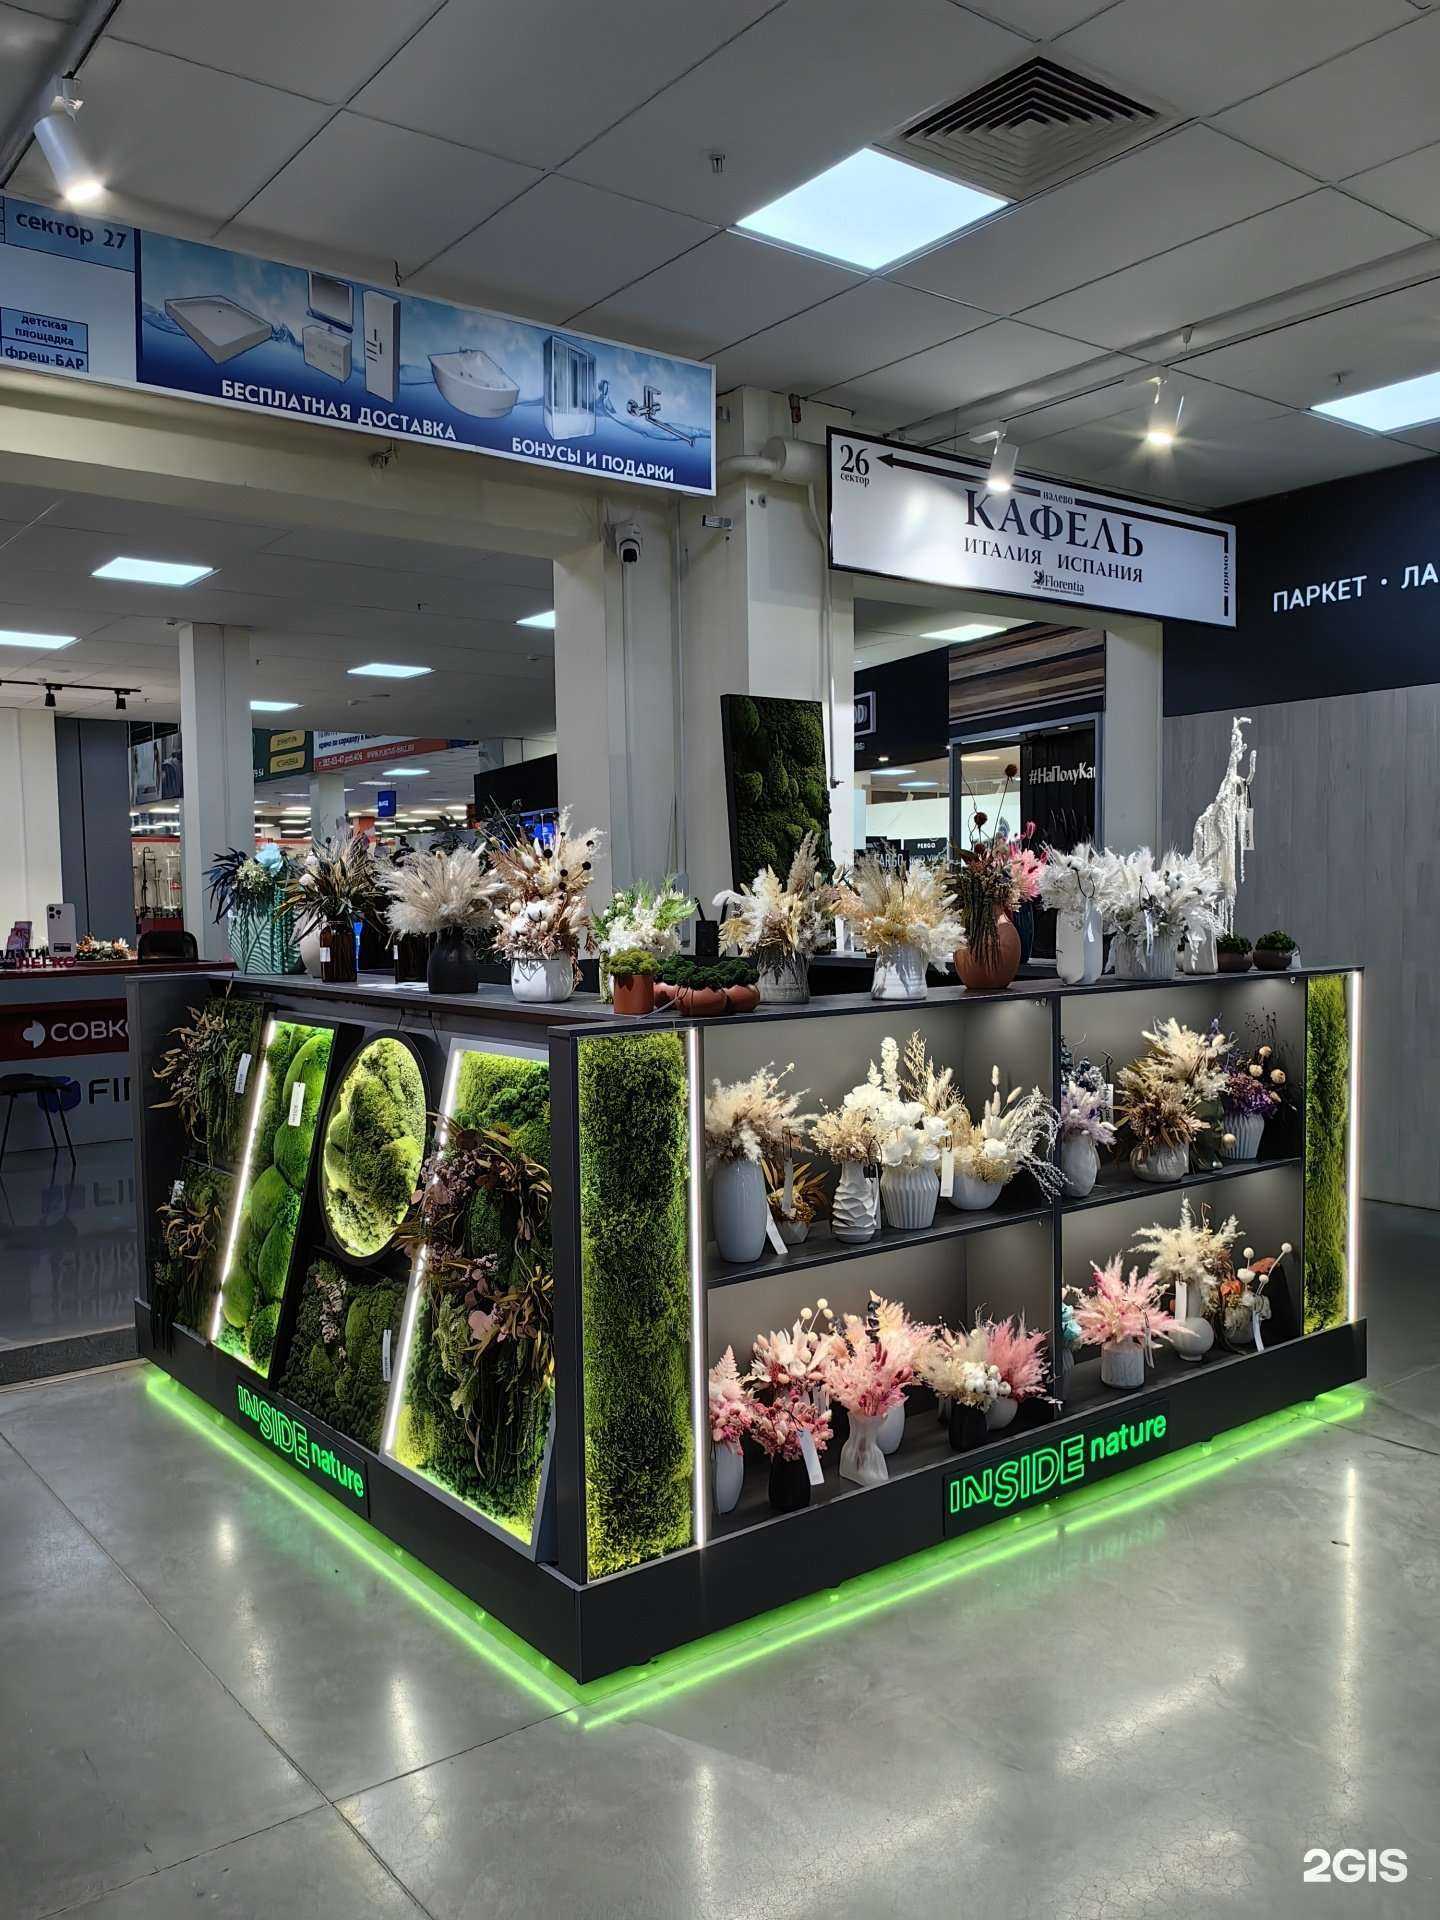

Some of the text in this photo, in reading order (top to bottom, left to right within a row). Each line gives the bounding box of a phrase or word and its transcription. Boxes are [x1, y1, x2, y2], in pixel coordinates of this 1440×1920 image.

[16, 213, 127, 249] сектор 27
[15, 327, 75, 346] площадка
[21, 315, 68, 332] детская
[5, 345, 84, 370] фреш-БАР
[221, 379, 457, 441] БЕСПЛАТНАЯ ДОСТАВКА
[512, 437, 675, 482] БОНУСЫ И ПОДАРКИ
[840, 444, 870, 476] 26
[840, 473, 870, 488] сектор
[964, 488, 1144, 557] КАФЕЛЬ
[964, 537, 1143, 583] ИТАЛИЯ ИСПАНИЯ
[1044, 574, 1085, 593] Florentia
[1273, 563, 1439, 613] ПАРКЕТ ЛА
[50, 1019, 129, 1042] СОВК
[237, 1383, 364, 1498] INSIDE nature
[950, 1414, 1167, 1514] INSIDE nature
